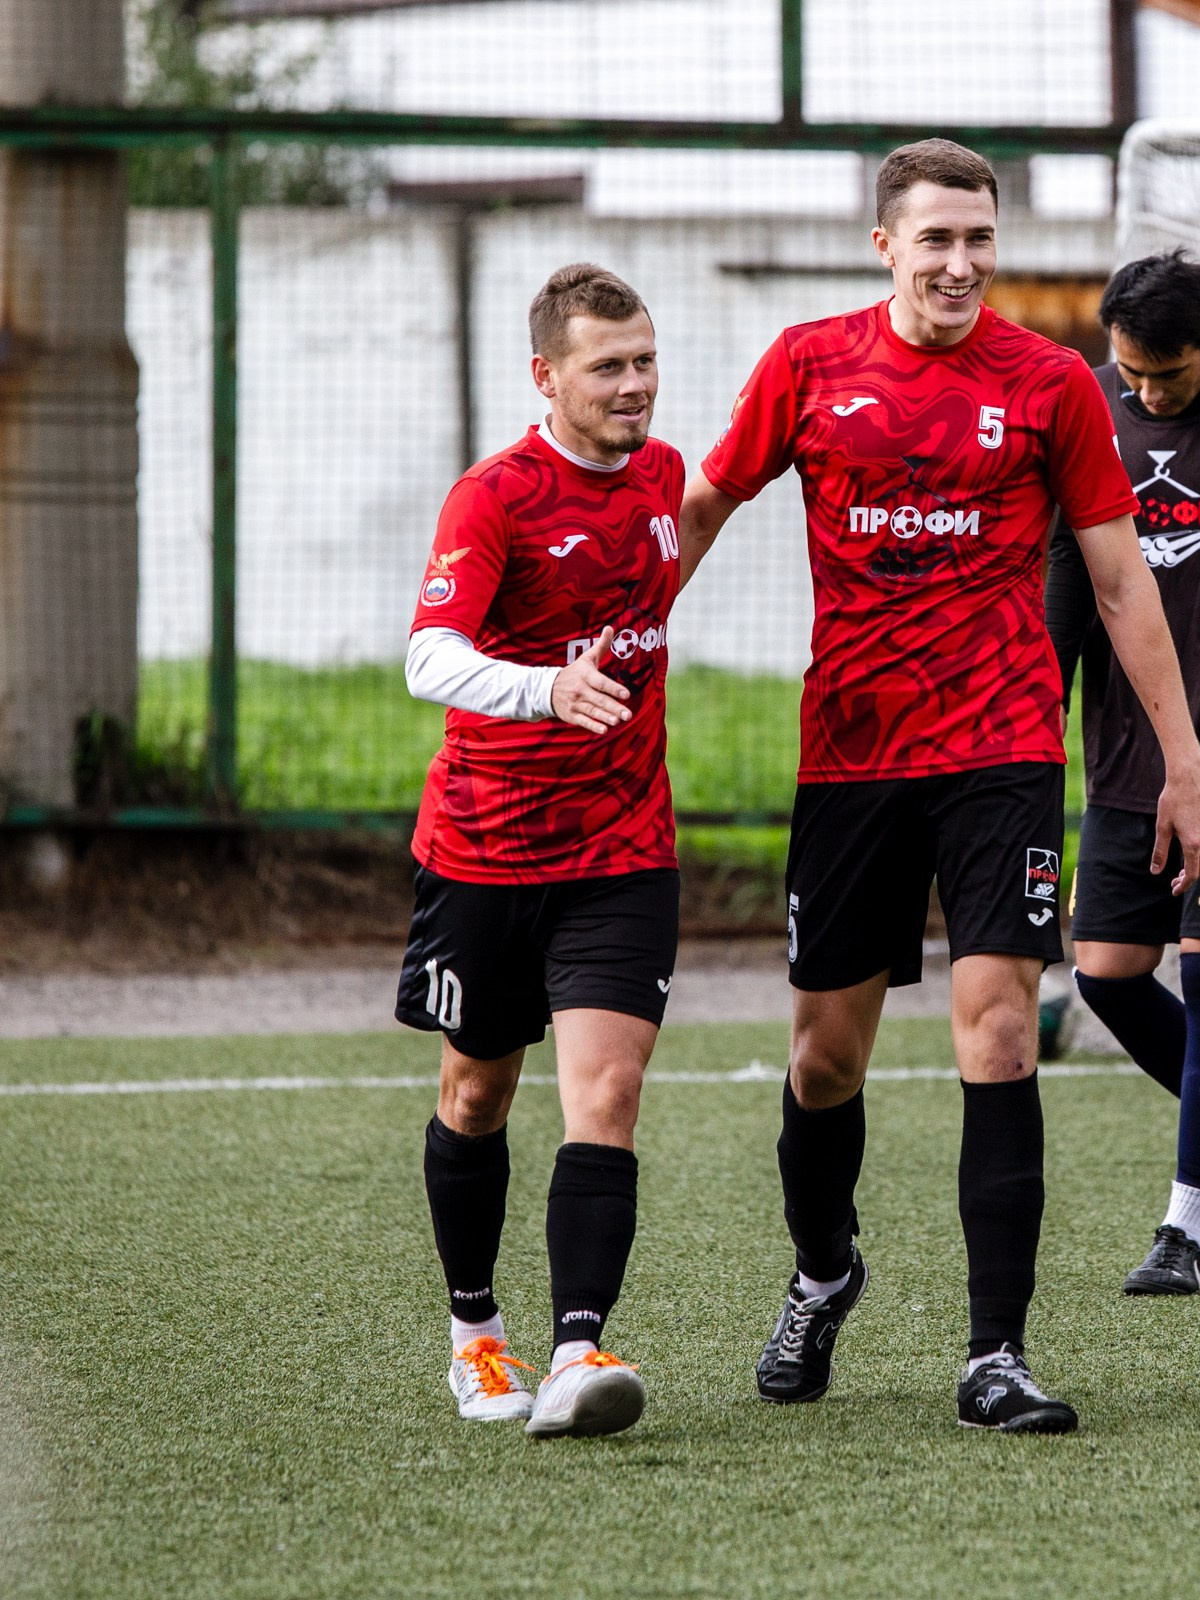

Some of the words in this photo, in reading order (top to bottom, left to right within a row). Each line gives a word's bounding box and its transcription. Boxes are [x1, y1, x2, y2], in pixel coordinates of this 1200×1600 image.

[977, 404, 1006, 449] 5
[649, 513, 680, 562] 10
[849, 505, 981, 539] ПРОФИ
[424, 957, 463, 1031] 10
